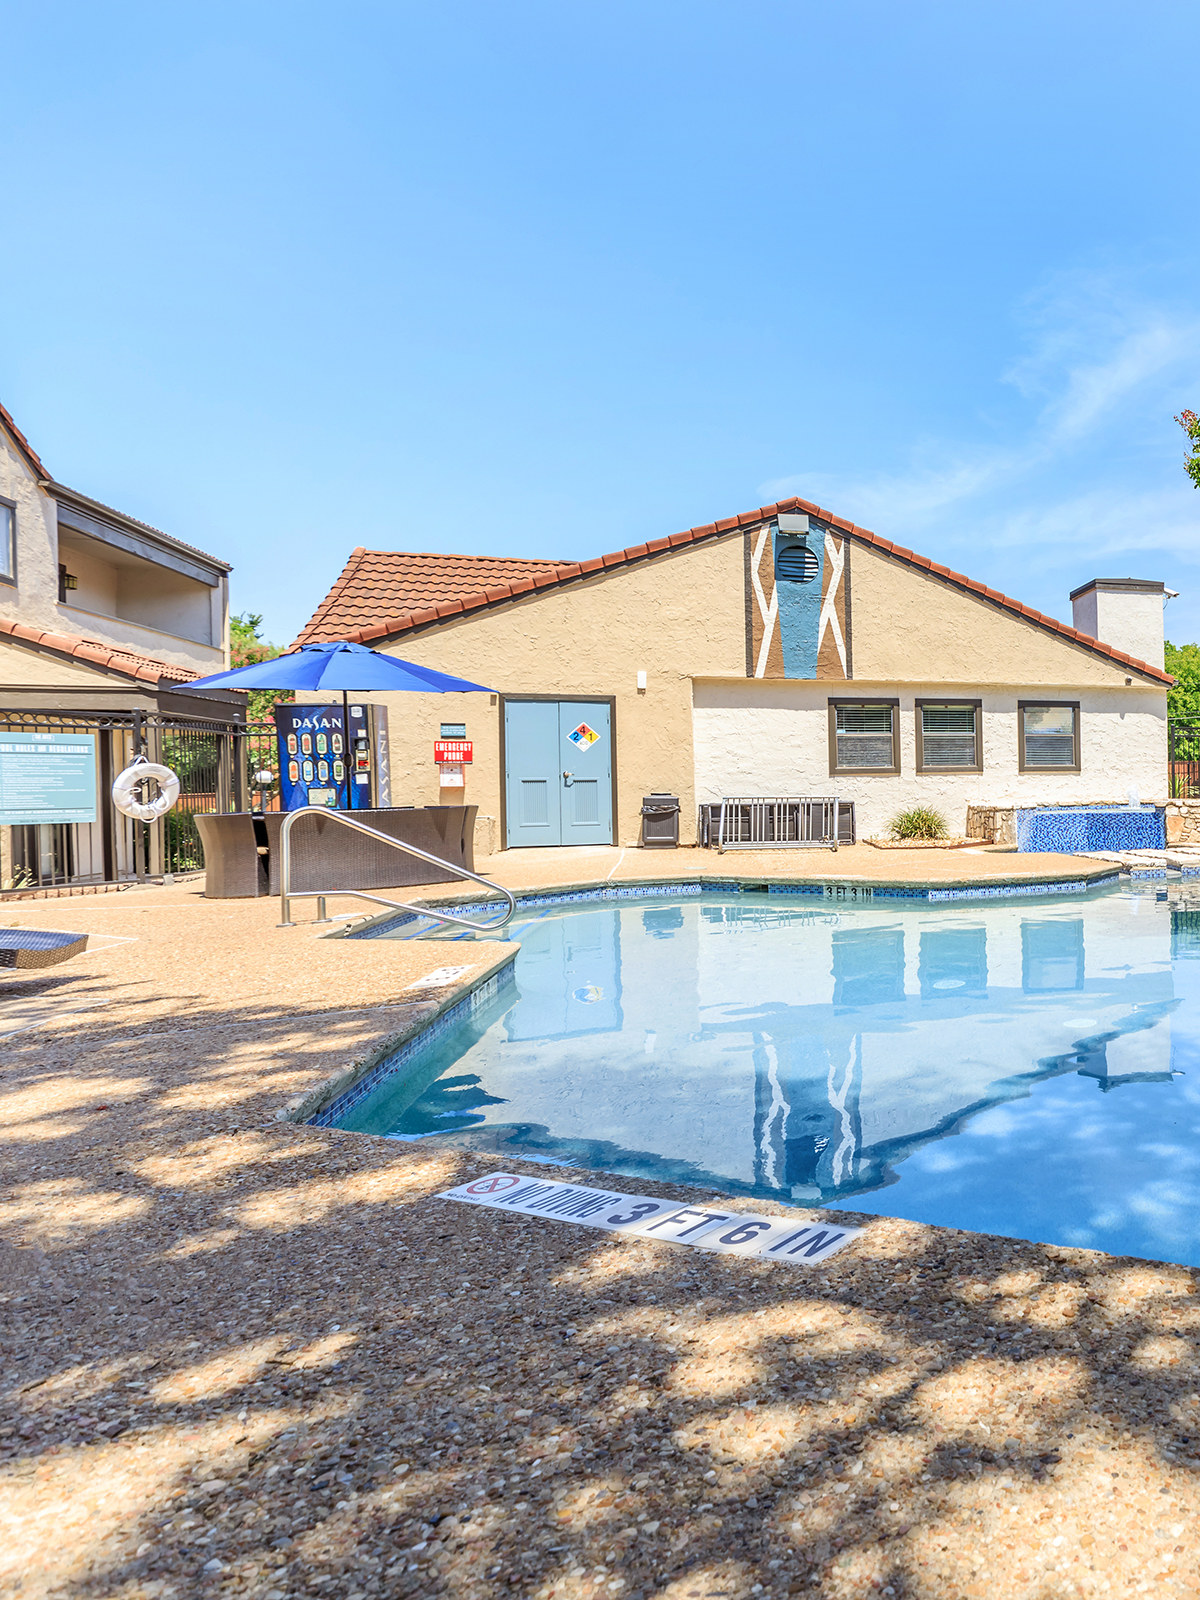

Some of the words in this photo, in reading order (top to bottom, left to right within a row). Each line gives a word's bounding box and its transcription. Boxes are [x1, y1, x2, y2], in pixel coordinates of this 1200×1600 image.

[292, 715, 342, 731] DASAN
[579, 725, 586, 734] 4
[573, 731, 579, 741] 2
[588, 732, 593, 741] 1
[0, 743, 13, 753] OOL
[15, 744, 36, 753] RULES
[48, 745, 89, 754] REGULATIONS
[435, 742, 472, 752] EMERGENCY
[443, 751, 464, 761] PHONE
[379, 730, 390, 803] ASANI
[862, 887, 872, 896] IN
[493, 1183, 554, 1204] NO
[525, 1188, 622, 1218] DIVING
[606, 1202, 660, 1225] 3
[646, 1209, 730, 1238] FT
[718, 1221, 772, 1245] 6
[768, 1227, 846, 1258] IN
